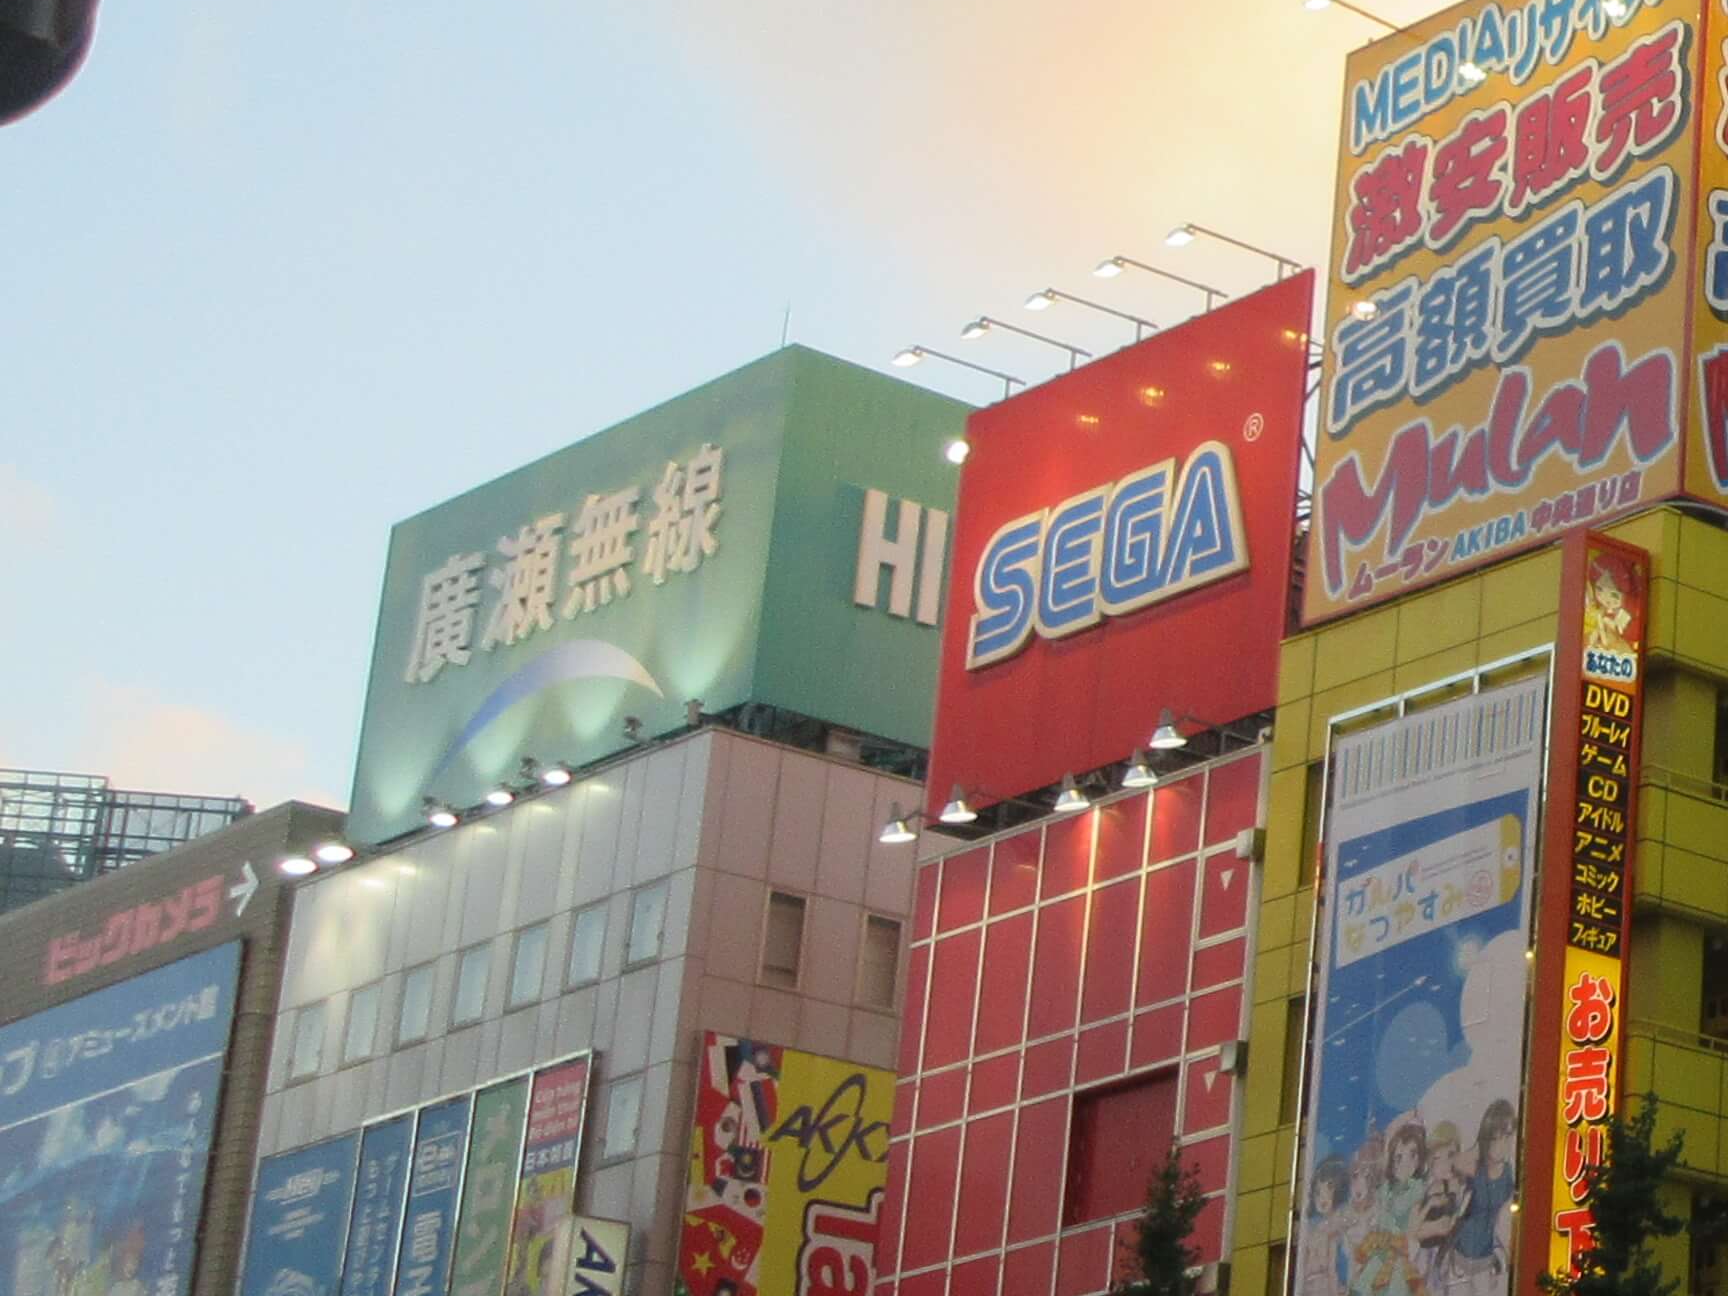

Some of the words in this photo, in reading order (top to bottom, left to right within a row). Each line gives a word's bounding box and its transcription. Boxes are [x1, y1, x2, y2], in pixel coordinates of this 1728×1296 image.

[1346, 24, 1684, 278] 激安販売
[1328, 170, 1670, 430] 高額買取
[1324, 344, 1675, 596] Mulan
[967, 442, 1249, 671] SEGA
[1348, 541, 1450, 600] ムーラン
[1451, 518, 1527, 562] AKIBA
[1584, 652, 1634, 677] あなたの
[1585, 686, 1630, 717] DVD
[1582, 714, 1630, 747] ブルーレイ
[1583, 745, 1627, 775] ゲーム
[1588, 776, 1618, 803] CD
[1578, 802, 1623, 833] アイドル
[1574, 832, 1622, 862] アニメ
[1575, 863, 1620, 892] コミック
[1575, 892, 1616, 918] ホビー
[1572, 921, 1618, 951] フィギュア
